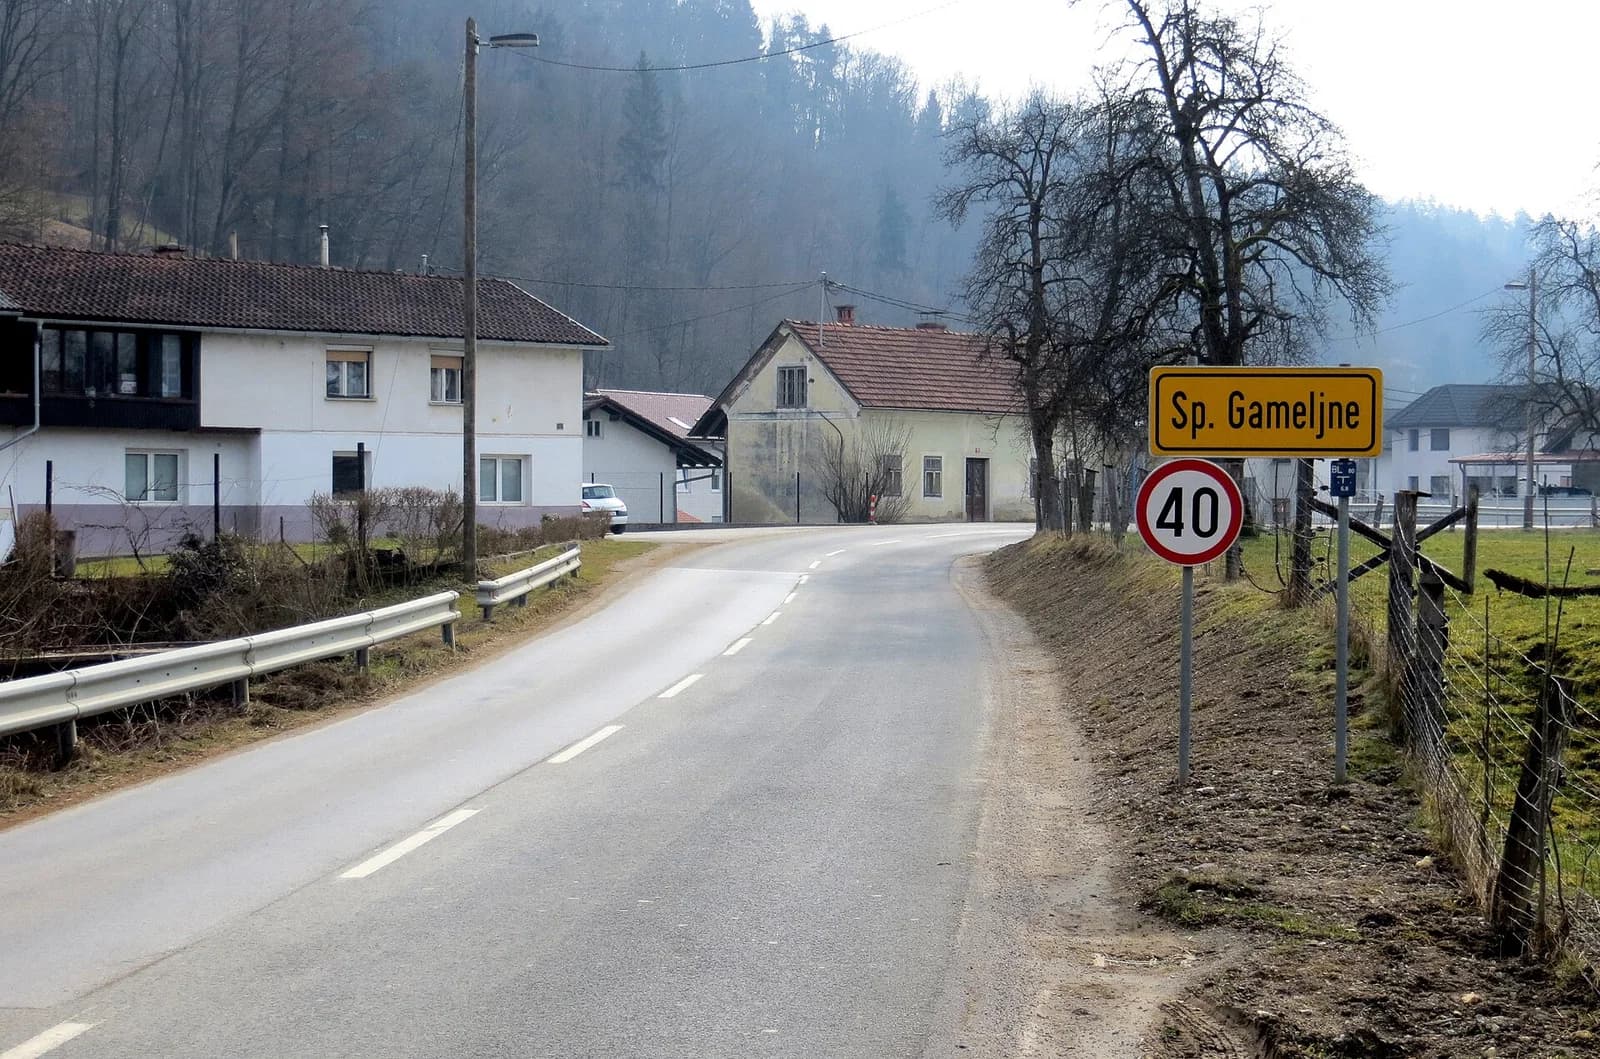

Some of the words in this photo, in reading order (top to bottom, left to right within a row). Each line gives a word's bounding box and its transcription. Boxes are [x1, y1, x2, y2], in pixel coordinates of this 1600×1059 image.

[1171, 390, 1215, 440] Sp.
[1228, 390, 1360, 440] Gameljne
[1155, 486, 1219, 539] 40
